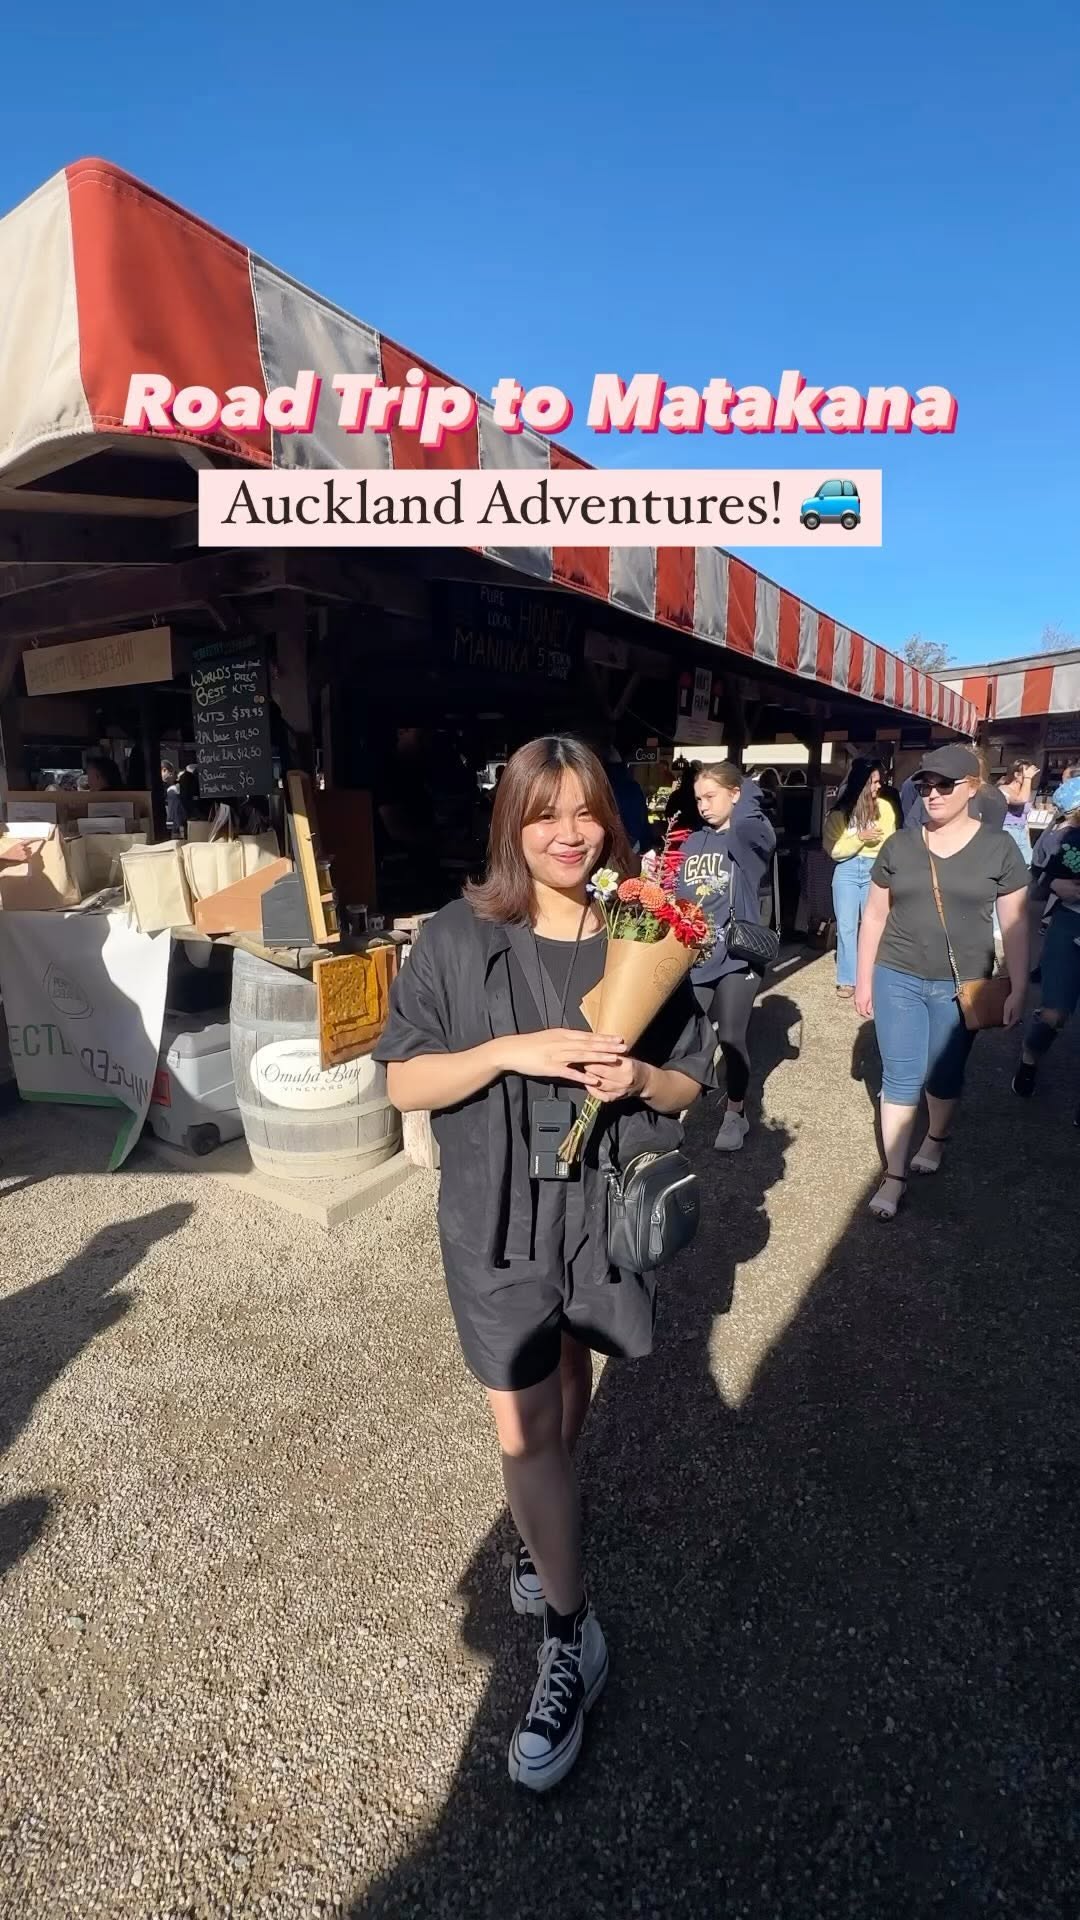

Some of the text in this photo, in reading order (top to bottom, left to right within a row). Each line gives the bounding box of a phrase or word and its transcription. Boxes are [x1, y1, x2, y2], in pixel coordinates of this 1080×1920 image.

[232, 683, 256, 694] KITS
[260, 1063, 362, 1085] Omaha Bay
[283, 1084, 343, 1093] VINEYARD
